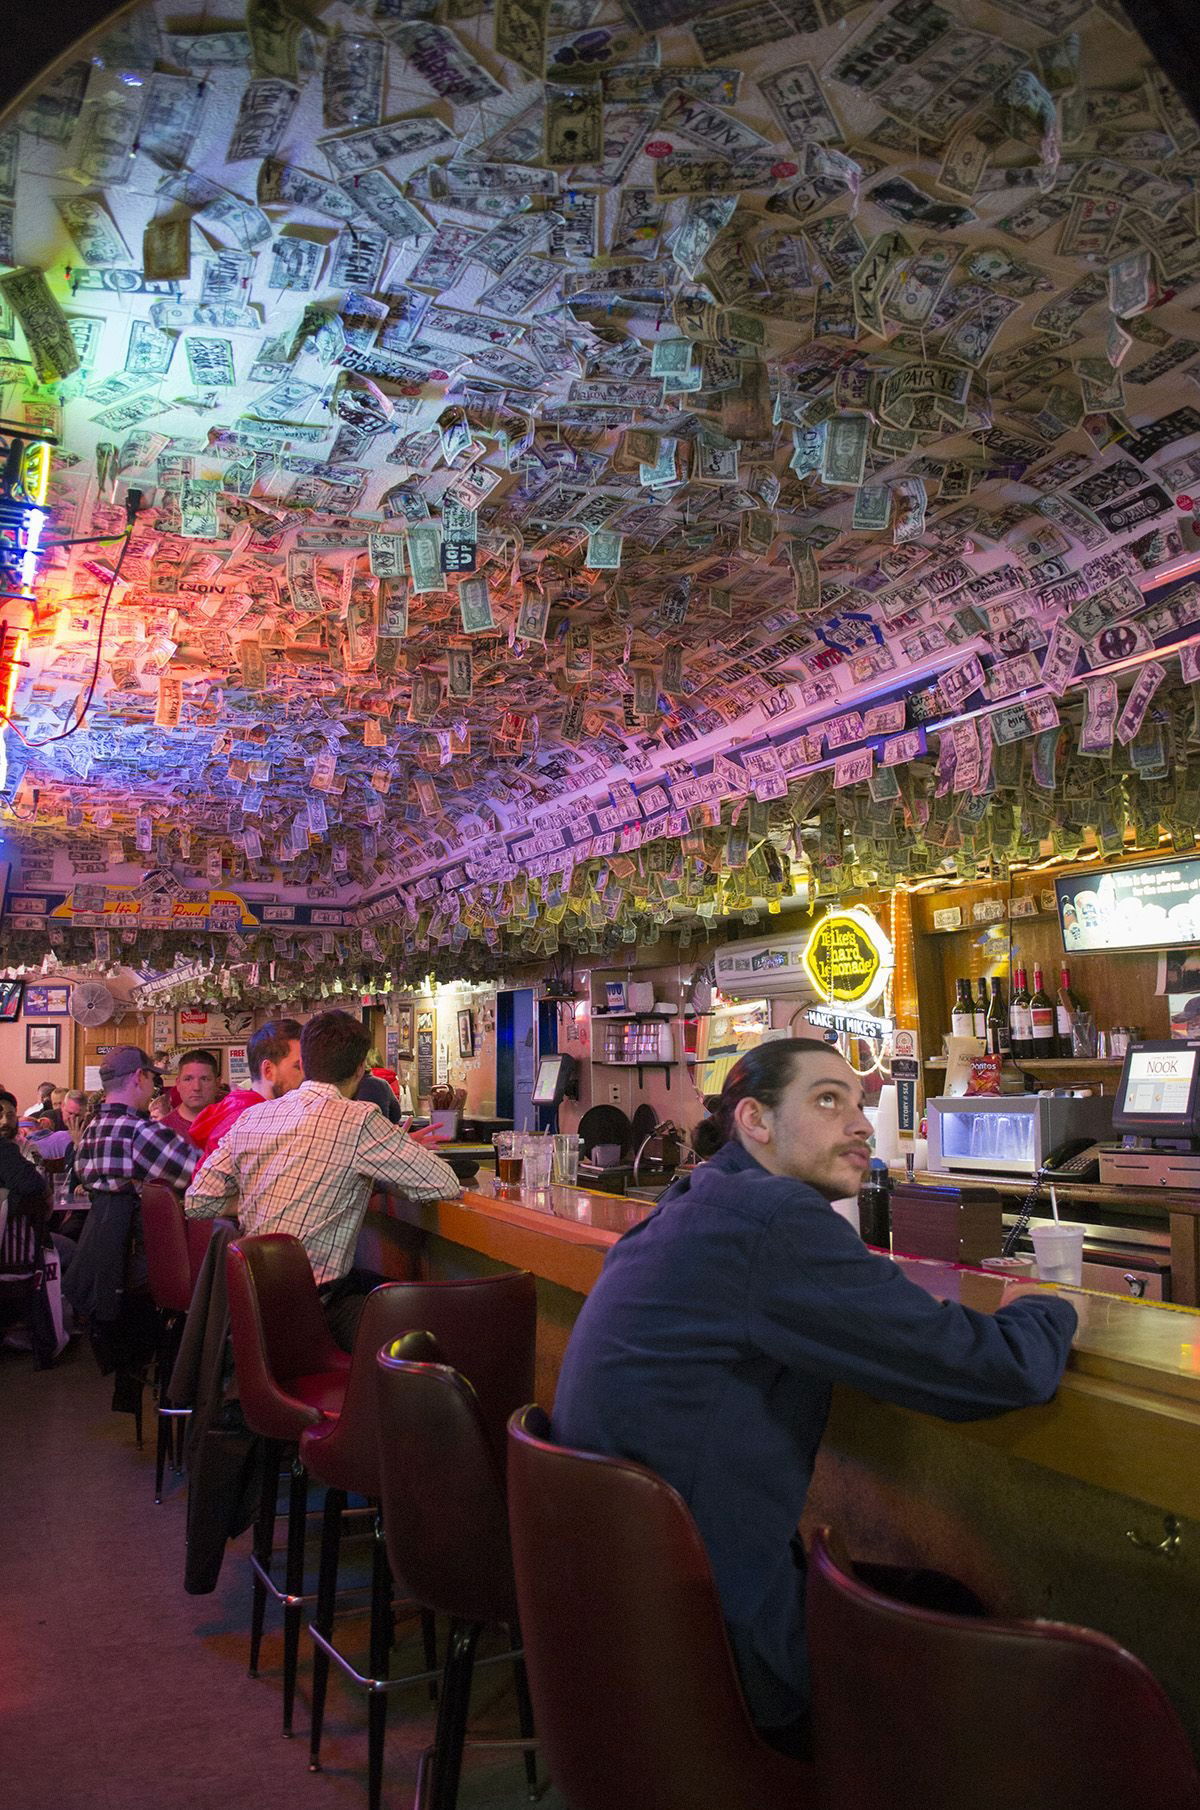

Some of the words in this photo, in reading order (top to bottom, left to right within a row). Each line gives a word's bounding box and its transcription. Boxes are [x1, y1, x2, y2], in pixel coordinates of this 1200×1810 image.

[345, 240, 376, 283] MICAH
[349, 348, 381, 367] Mike
[445, 542, 458, 569] HOP
[460, 543, 472, 564] UP
[1006, 712, 1030, 726] MIKE
[809, 1011, 834, 1028] MAKE
[835, 1016, 844, 1030] IT
[847, 1018, 877, 1036] MIKE'S
[1147, 1060, 1178, 1073] NOOK
